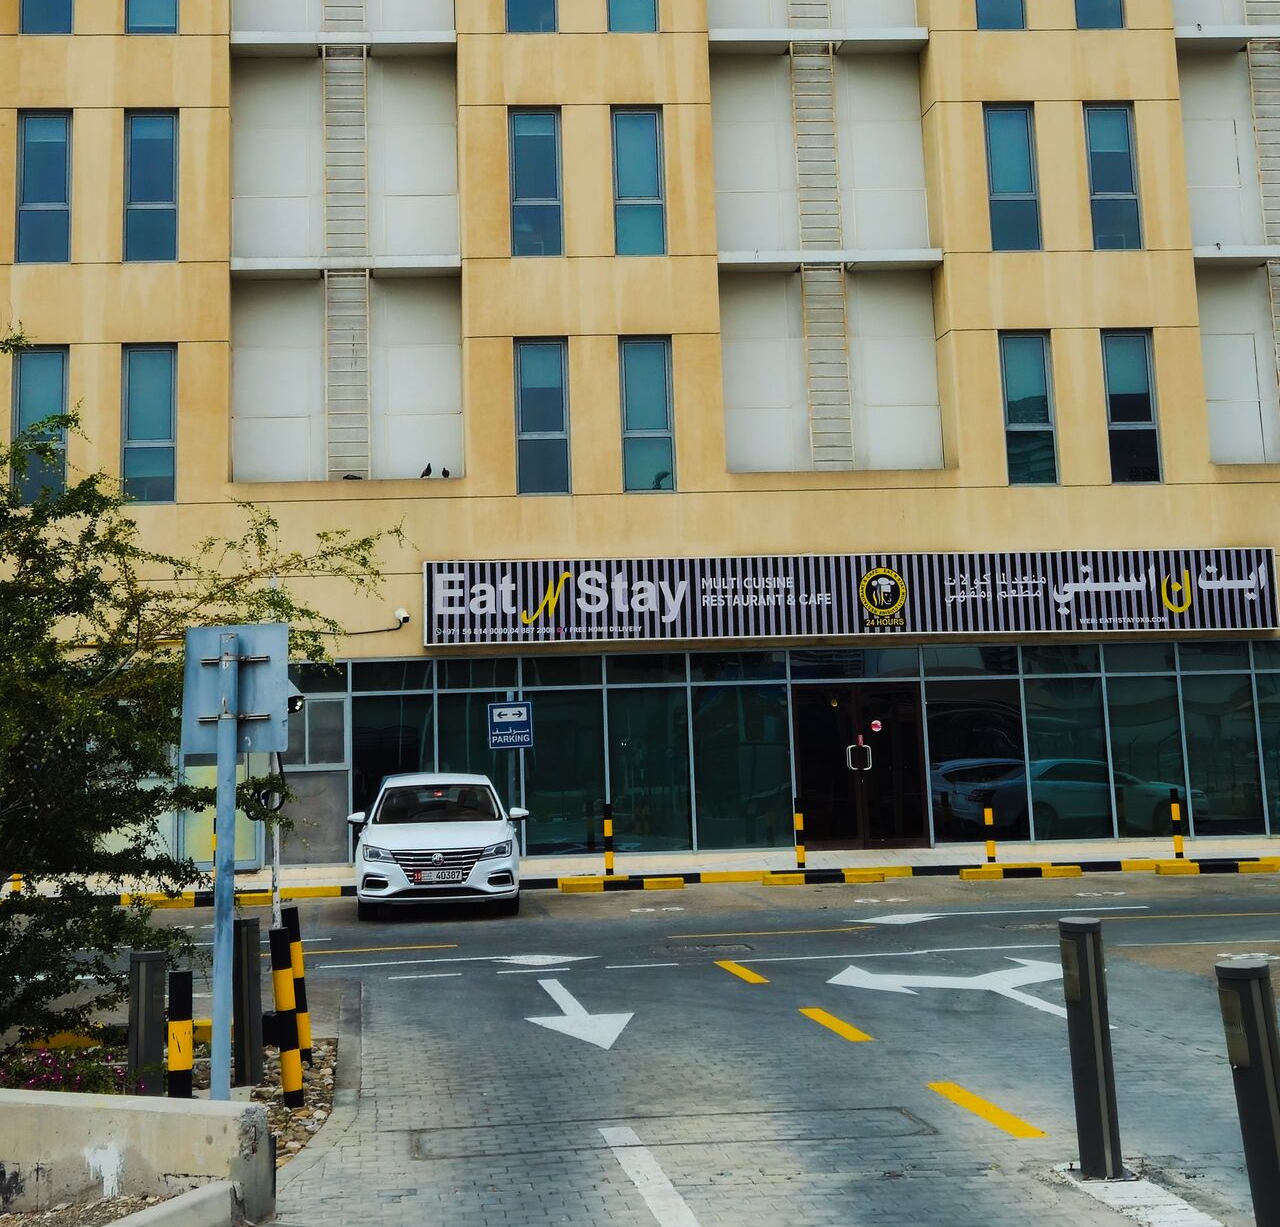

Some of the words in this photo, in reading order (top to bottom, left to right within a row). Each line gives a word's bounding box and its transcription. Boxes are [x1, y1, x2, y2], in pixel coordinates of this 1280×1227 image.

[701, 578, 741, 589] MULTI
[744, 577, 794, 589] CUISINE
[434, 571, 517, 615] Eat
[521, 571, 573, 624] N
[576, 570, 688, 623] Stay
[702, 594, 785, 606] RESTAURANT
[787, 593, 795, 605] &
[799, 593, 831, 605] CAFE
[876, 618, 905, 626] HOURS
[492, 734, 530, 743] PARKING
[435, 871, 461, 880] 40387
